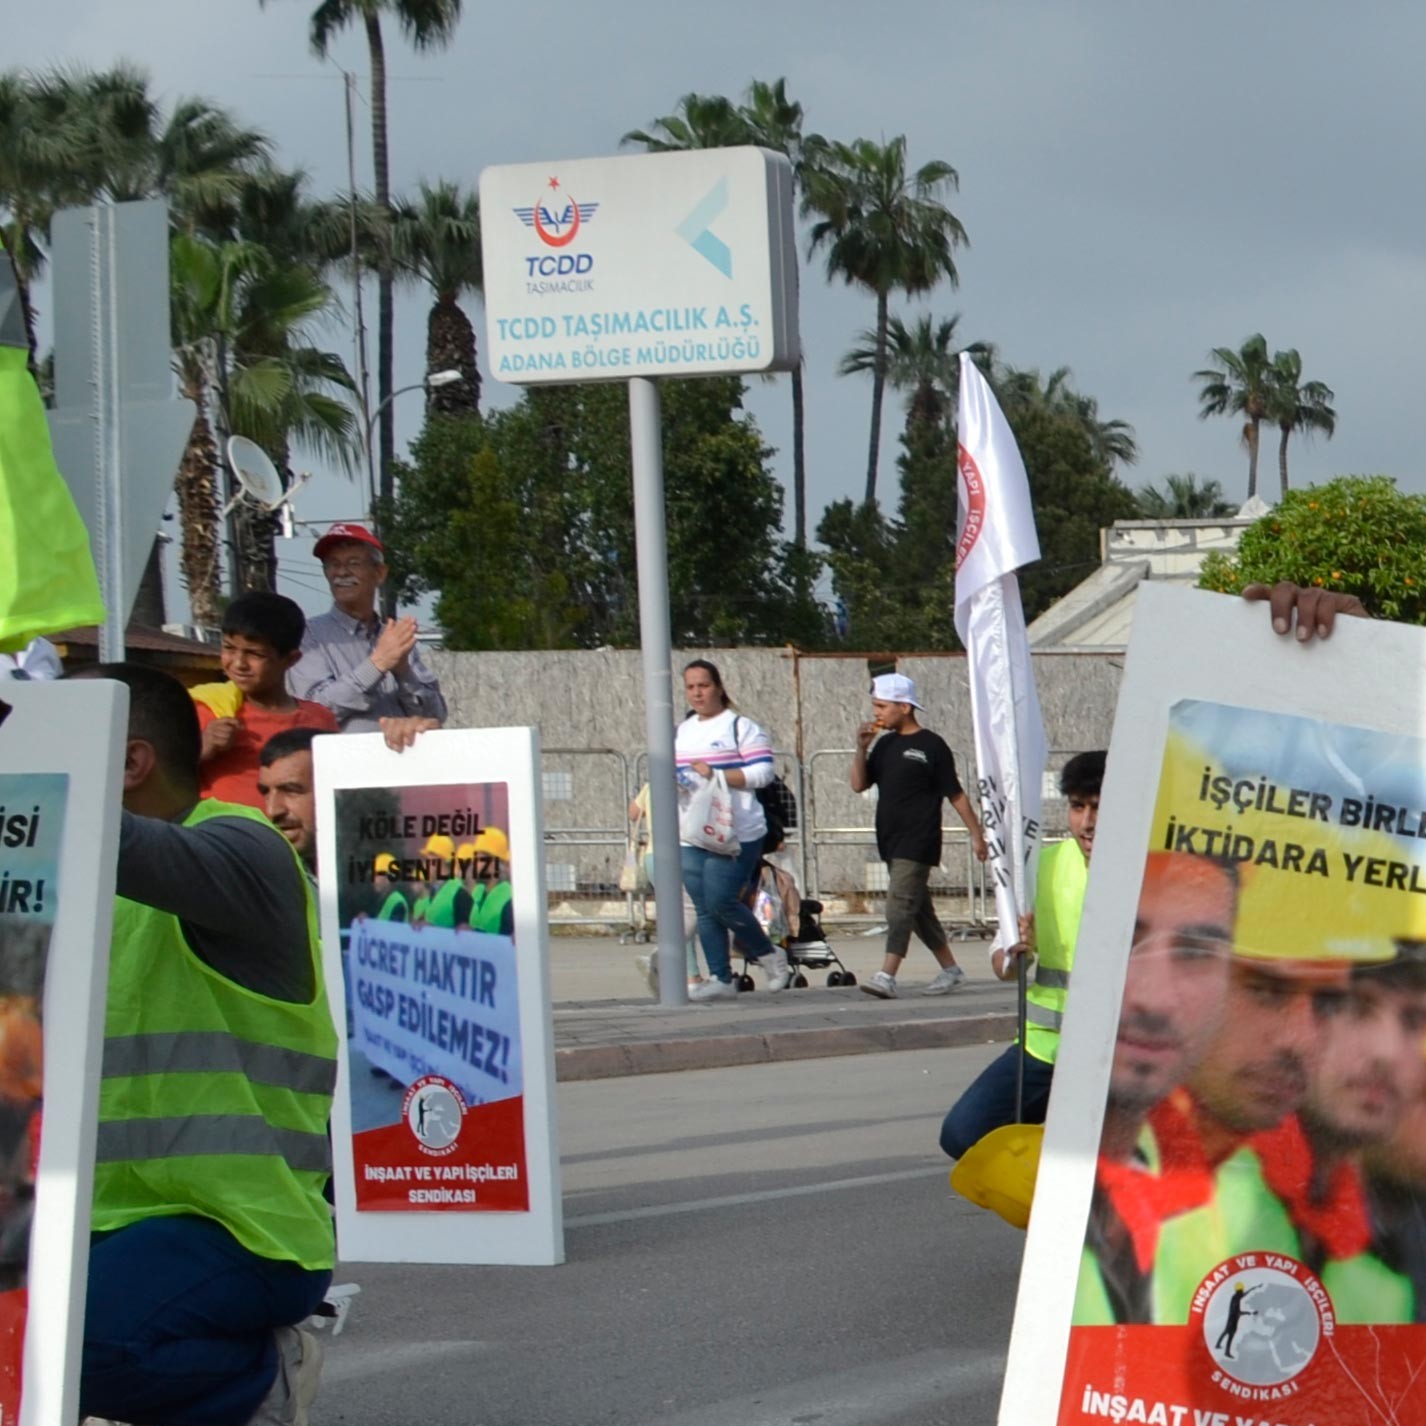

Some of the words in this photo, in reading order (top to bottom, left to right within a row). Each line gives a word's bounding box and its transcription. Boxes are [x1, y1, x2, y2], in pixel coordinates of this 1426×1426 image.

[525, 254, 593, 277] TCDD
[497, 316, 556, 341] TCDD
[563, 306, 709, 343] TAŞIMACILIK
[715, 303, 759, 332] A.Ş.
[499, 350, 567, 373] ADANA
[571, 345, 632, 369] BÖLGE
[637, 335, 760, 365] MÜDÜRLÜĞÜ
[1198, 767, 1333, 823] İŞÇİLER
[360, 810, 417, 840] KÖLE
[421, 808, 485, 838] DEĞİL
[1164, 815, 1330, 877] İKTİDARA
[357, 928, 410, 978] ÜCRET
[414, 947, 497, 1009] HAKTIR
[357, 978, 395, 1020] GASP
[397, 990, 511, 1085] EDİLEMEZ!
[365, 1163, 411, 1183] İNŞAAT
[414, 1166, 432, 1180] VE
[434, 1166, 464, 1181] YAPI
[466, 1162, 518, 1183] İŞÇİLERİ
[409, 1186, 476, 1203] SENDİKASI
[1236, 1255, 1257, 1269] VE
[1265, 1254, 1299, 1275] YAPI
